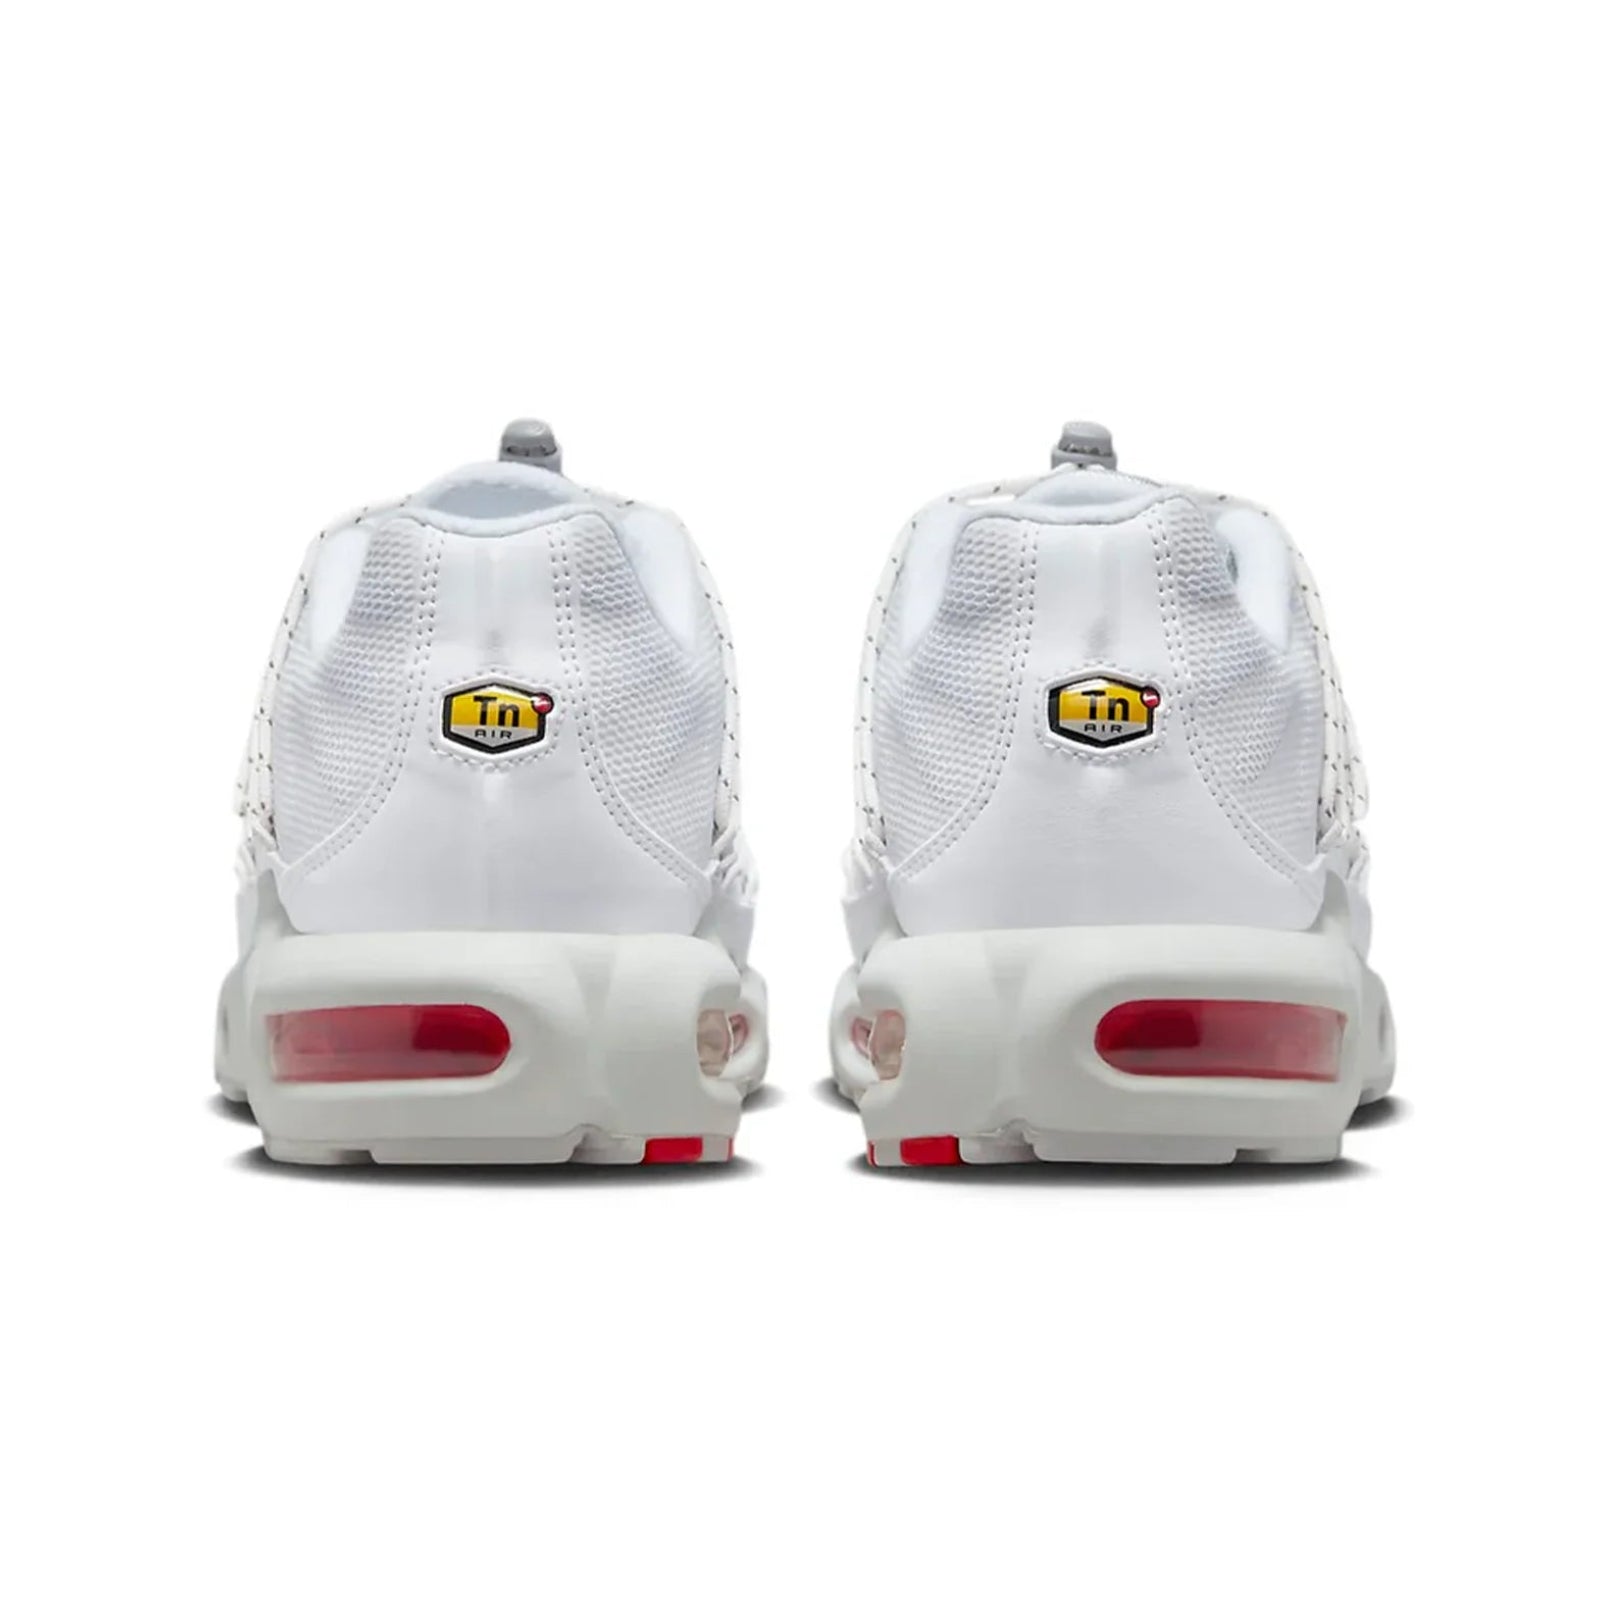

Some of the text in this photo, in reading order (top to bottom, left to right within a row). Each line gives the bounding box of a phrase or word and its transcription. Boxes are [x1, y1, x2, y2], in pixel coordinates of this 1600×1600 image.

[473, 695, 520, 728] Tn
[1081, 690, 1130, 721] Tn
[474, 729, 513, 739] AIR
[1084, 723, 1123, 733] AIR
